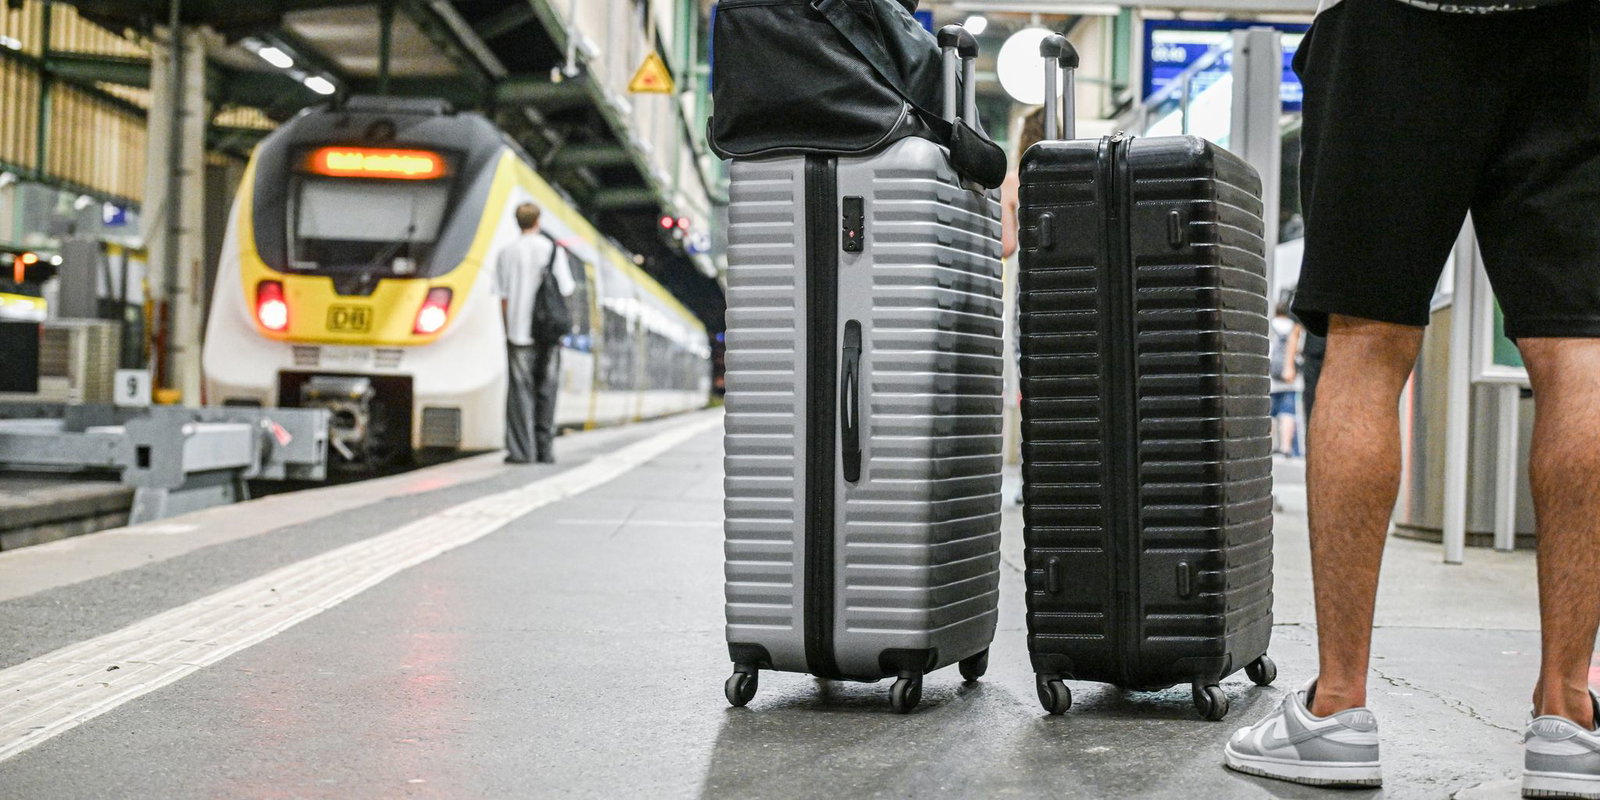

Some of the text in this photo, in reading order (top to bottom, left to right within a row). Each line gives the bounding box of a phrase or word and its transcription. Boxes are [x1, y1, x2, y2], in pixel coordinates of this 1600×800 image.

[127, 375, 138, 399] 9
[1351, 711, 1374, 724] NIKE
[1539, 719, 1567, 733] NIKE
